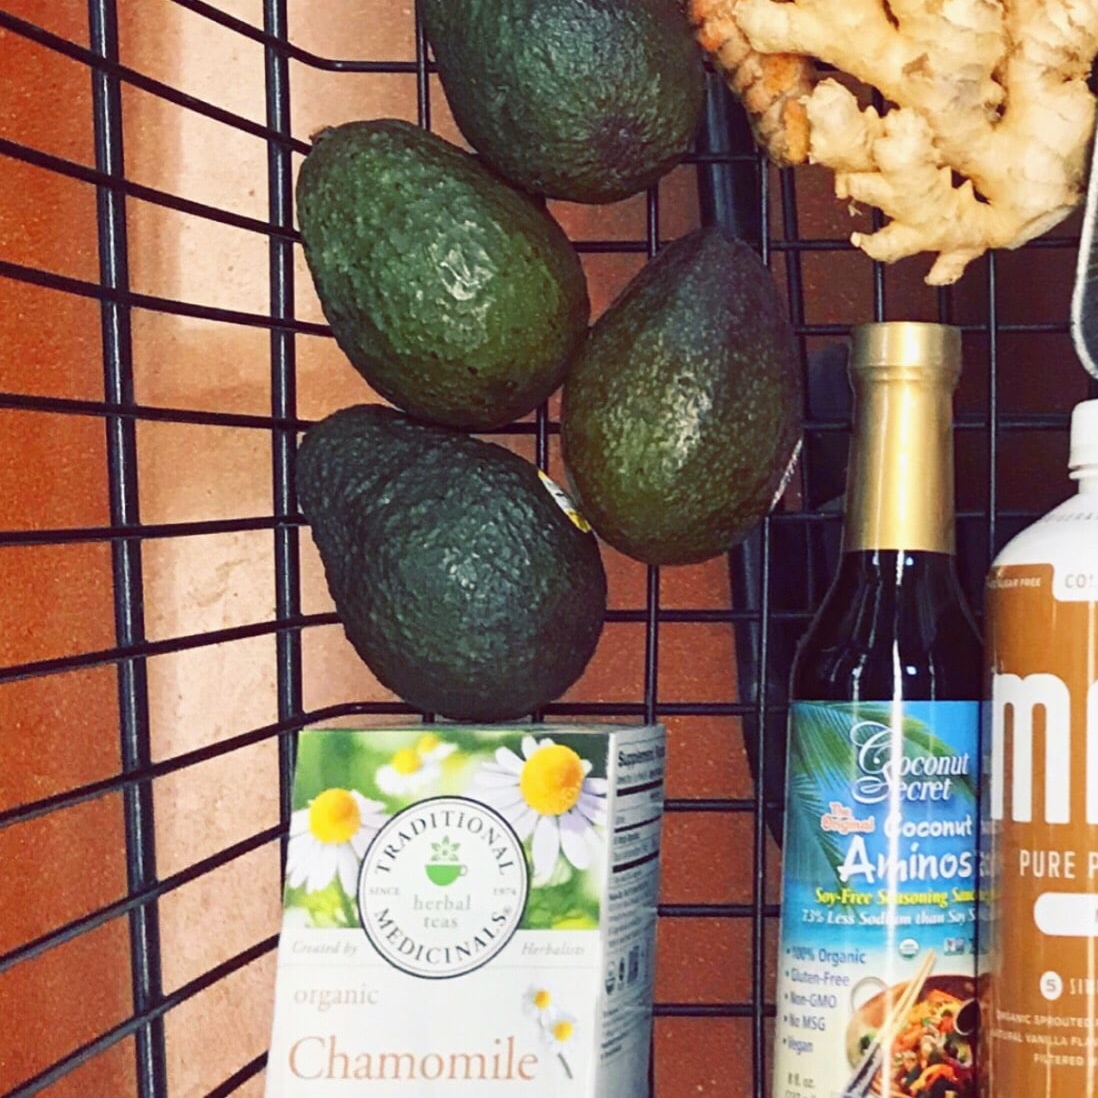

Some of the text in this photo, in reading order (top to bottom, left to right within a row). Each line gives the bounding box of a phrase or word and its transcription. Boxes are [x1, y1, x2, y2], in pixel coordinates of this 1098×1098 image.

[851, 721, 970, 776] Coconut
[852, 761, 954, 804] Secret
[884, 812, 973, 838] Coconut
[375, 810, 514, 876] TRADITIONAL
[836, 834, 973, 884] Aminos
[1020, 849, 1076, 879] PURE
[369, 886, 400, 896] SINCE
[815, 887, 873, 908] Soy-Free
[413, 895, 472, 911] herbal
[424, 914, 459, 928] teas
[826, 909, 856, 925] Less
[914, 908, 946, 924] than
[374, 907, 508, 964] MEDICINALS
[292, 940, 359, 959] Created by
[521, 941, 585, 956] Herbalists
[818, 948, 866, 967] Organic
[790, 967, 850, 987] Gluten-Free
[1046, 979, 1057, 992] 5
[293, 983, 379, 1012] organic
[789, 991, 838, 1008] Non-GMO
[802, 1015, 826, 1032] MSG
[1034, 1015, 1090, 1028] SPROUTED
[786, 1037, 814, 1056] Vegan
[1025, 1033, 1068, 1046] VANILLA
[288, 1034, 540, 1082] Chamomile
[1034, 1053, 1084, 1067] FILTERED
